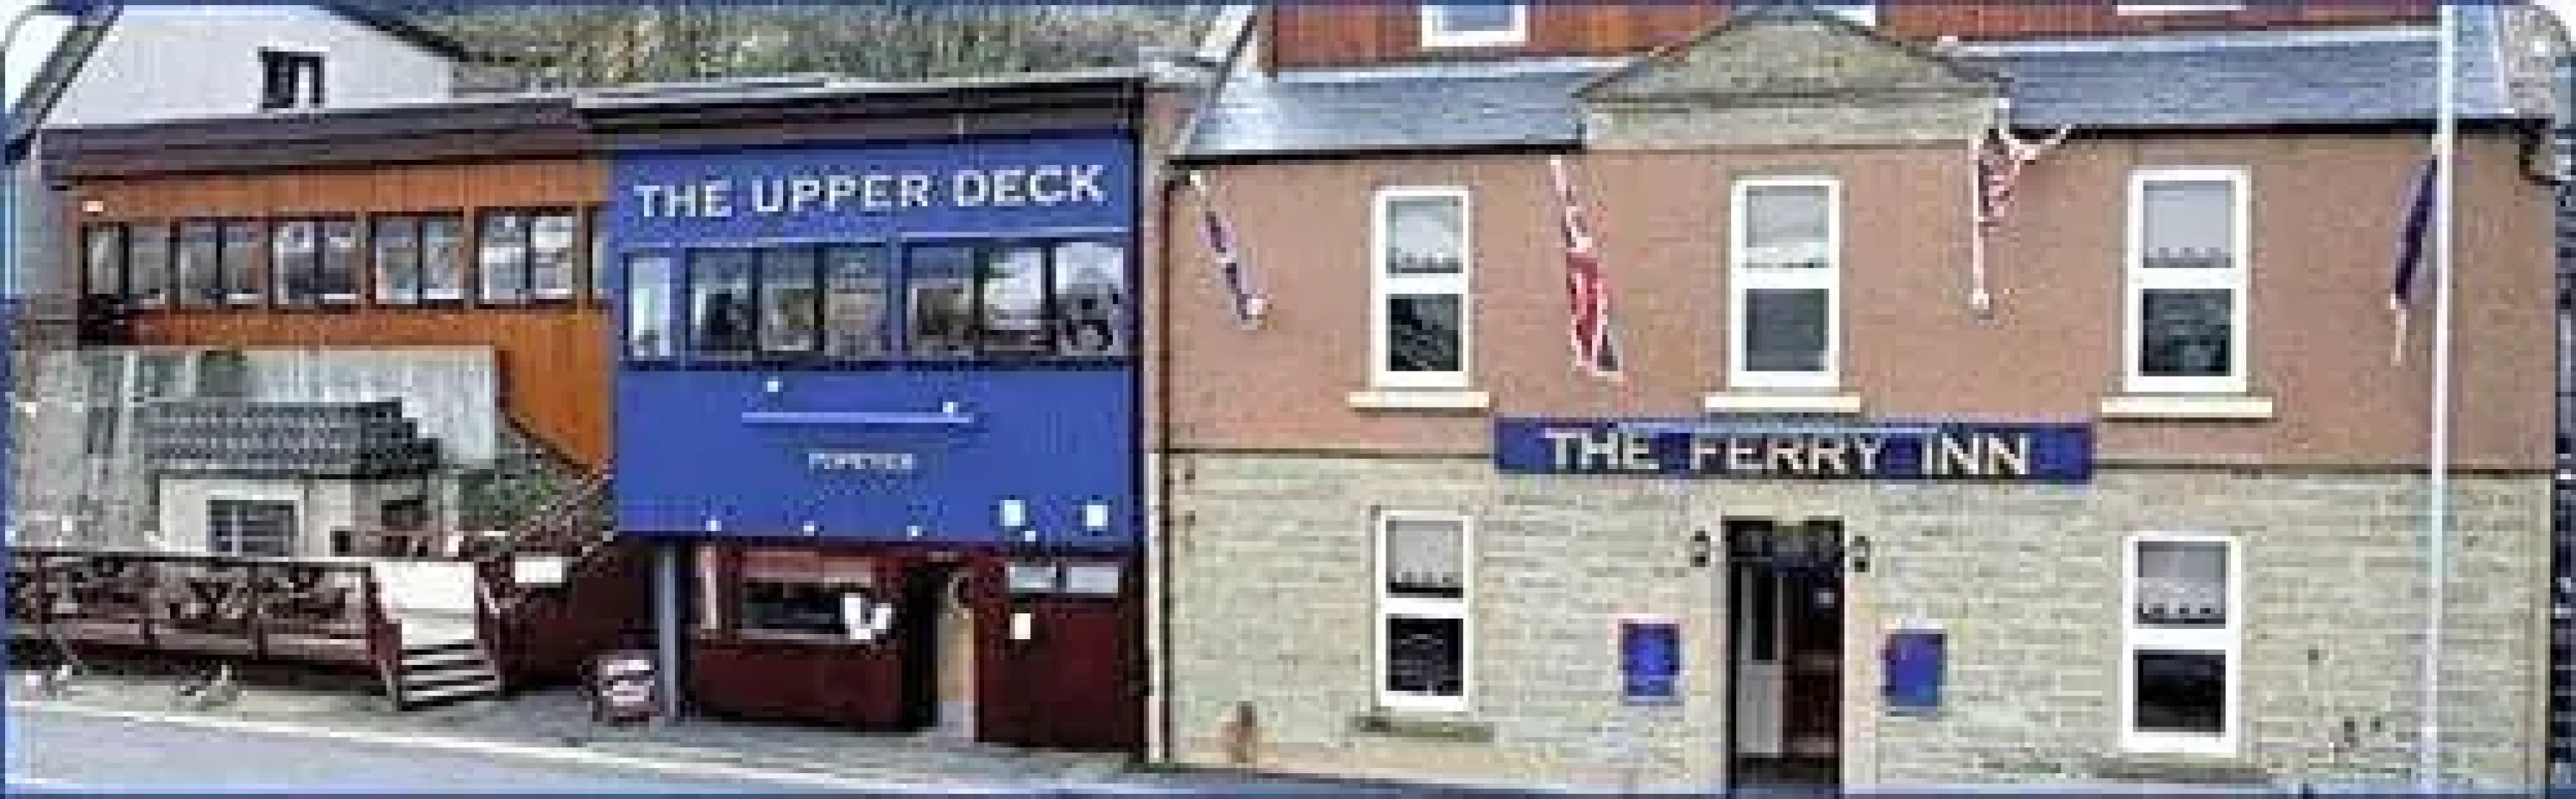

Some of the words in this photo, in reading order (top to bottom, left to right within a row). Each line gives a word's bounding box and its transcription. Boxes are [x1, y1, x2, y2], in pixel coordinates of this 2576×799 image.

[634, 180, 732, 217] THE
[752, 175, 928, 212] UPPER
[953, 164, 1105, 206] DECK
[1545, 428, 1659, 470] THE
[1689, 433, 1881, 473] FERRY
[1923, 433, 2030, 475] INN
